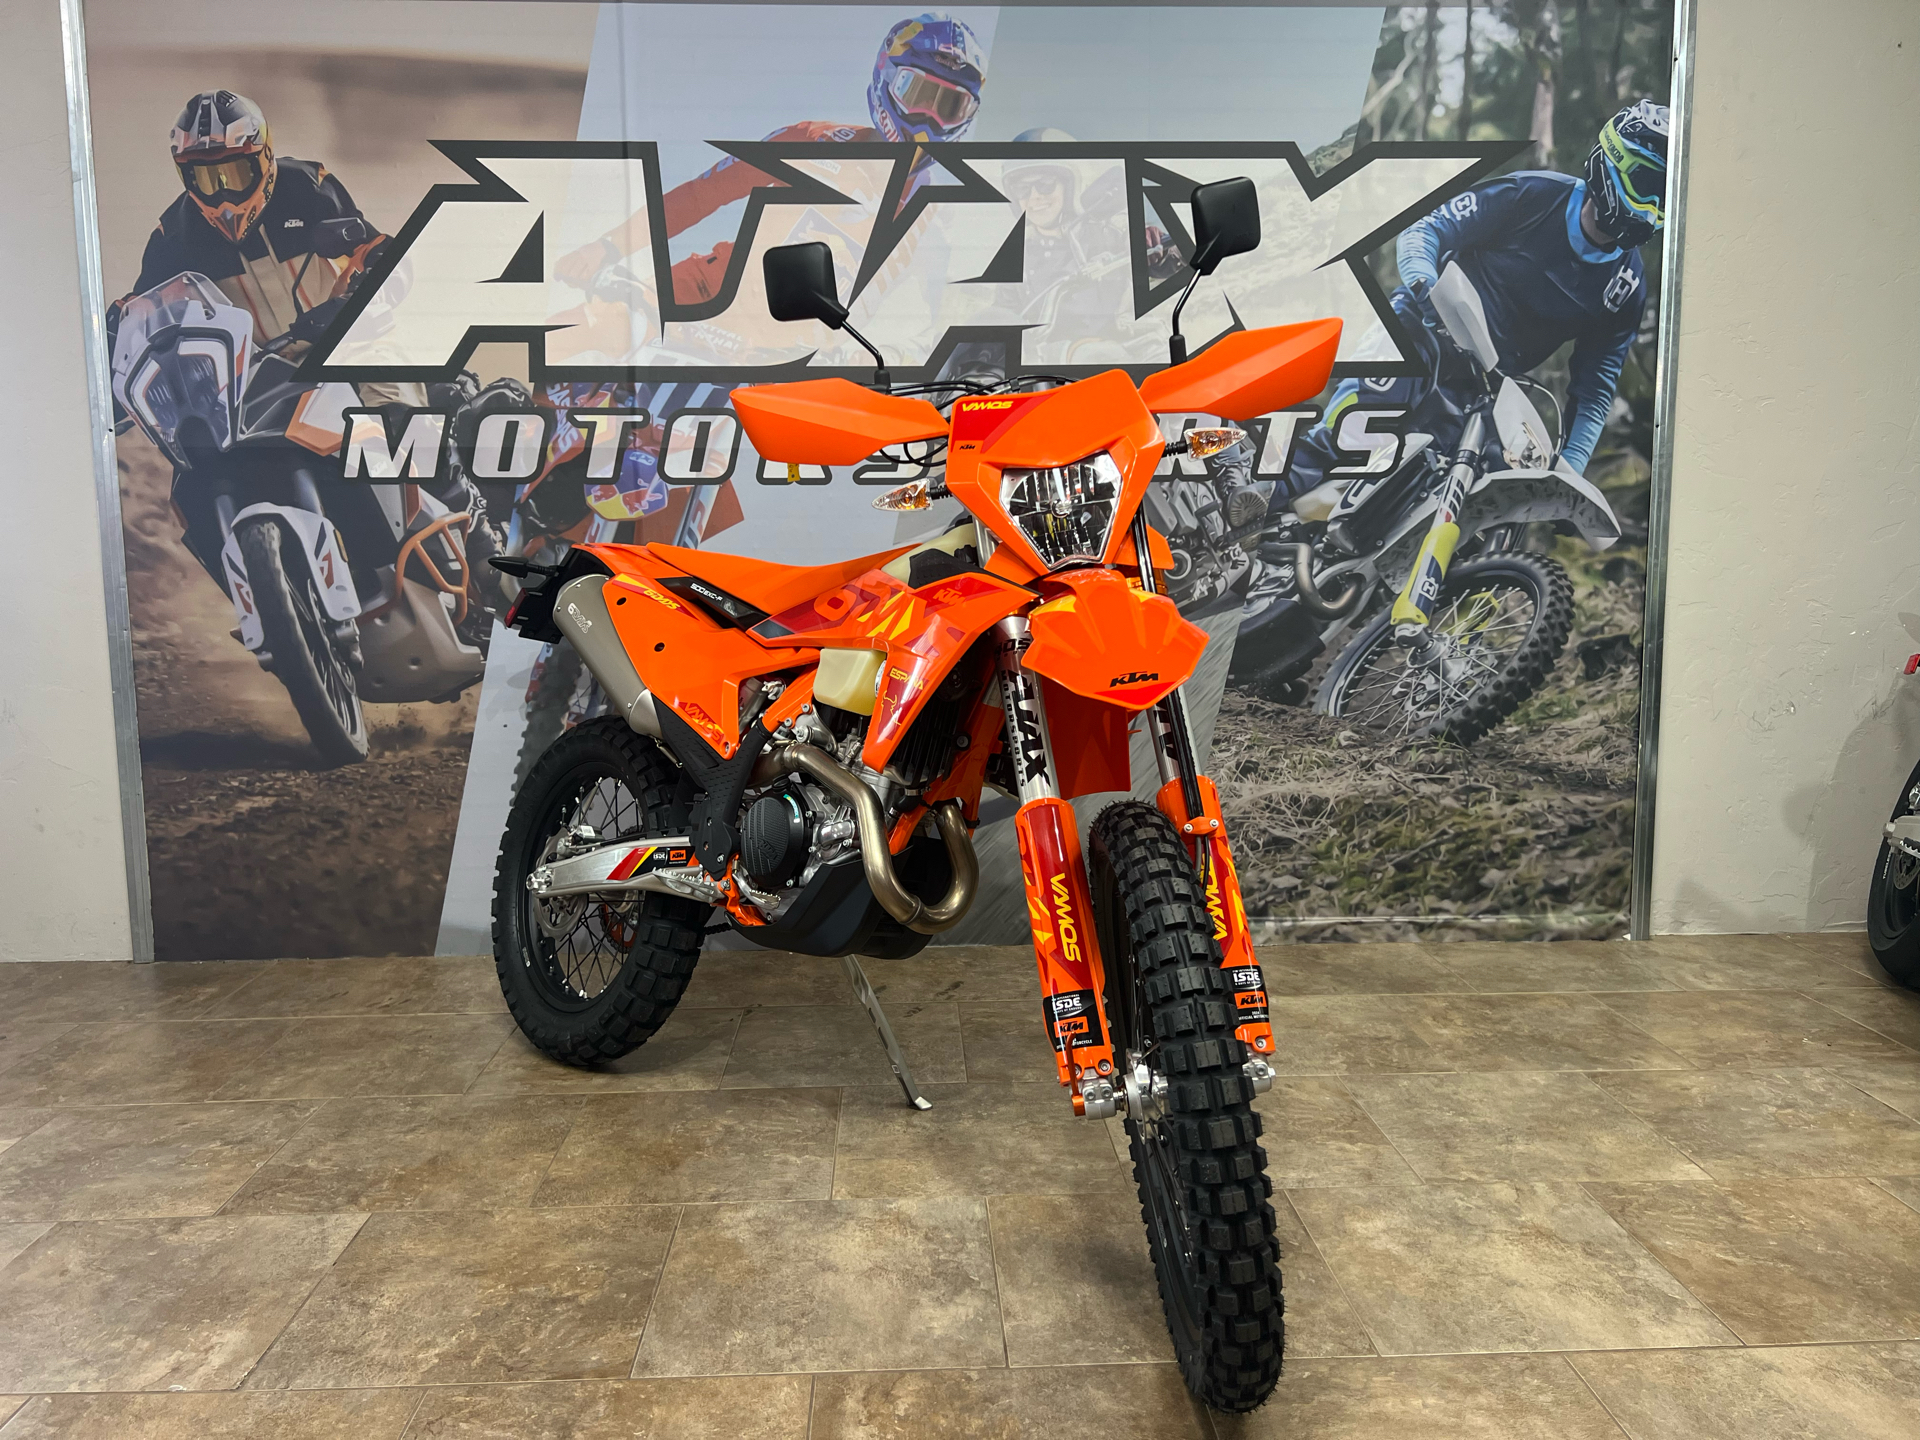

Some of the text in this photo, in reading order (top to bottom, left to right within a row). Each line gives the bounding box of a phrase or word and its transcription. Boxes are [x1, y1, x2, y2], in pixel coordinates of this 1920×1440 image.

[290, 140, 1536, 382] AJAX
[962, 401, 1013, 411] VAMOS
[1110, 671, 1158, 687] KTM
[1200, 853, 1228, 941] VAMO
[1051, 873, 1082, 963] VAMOS
[1052, 997, 1082, 1012] ISDE
[1240, 995, 1263, 1005] KTM
[1059, 1020, 1084, 1032] KTM
